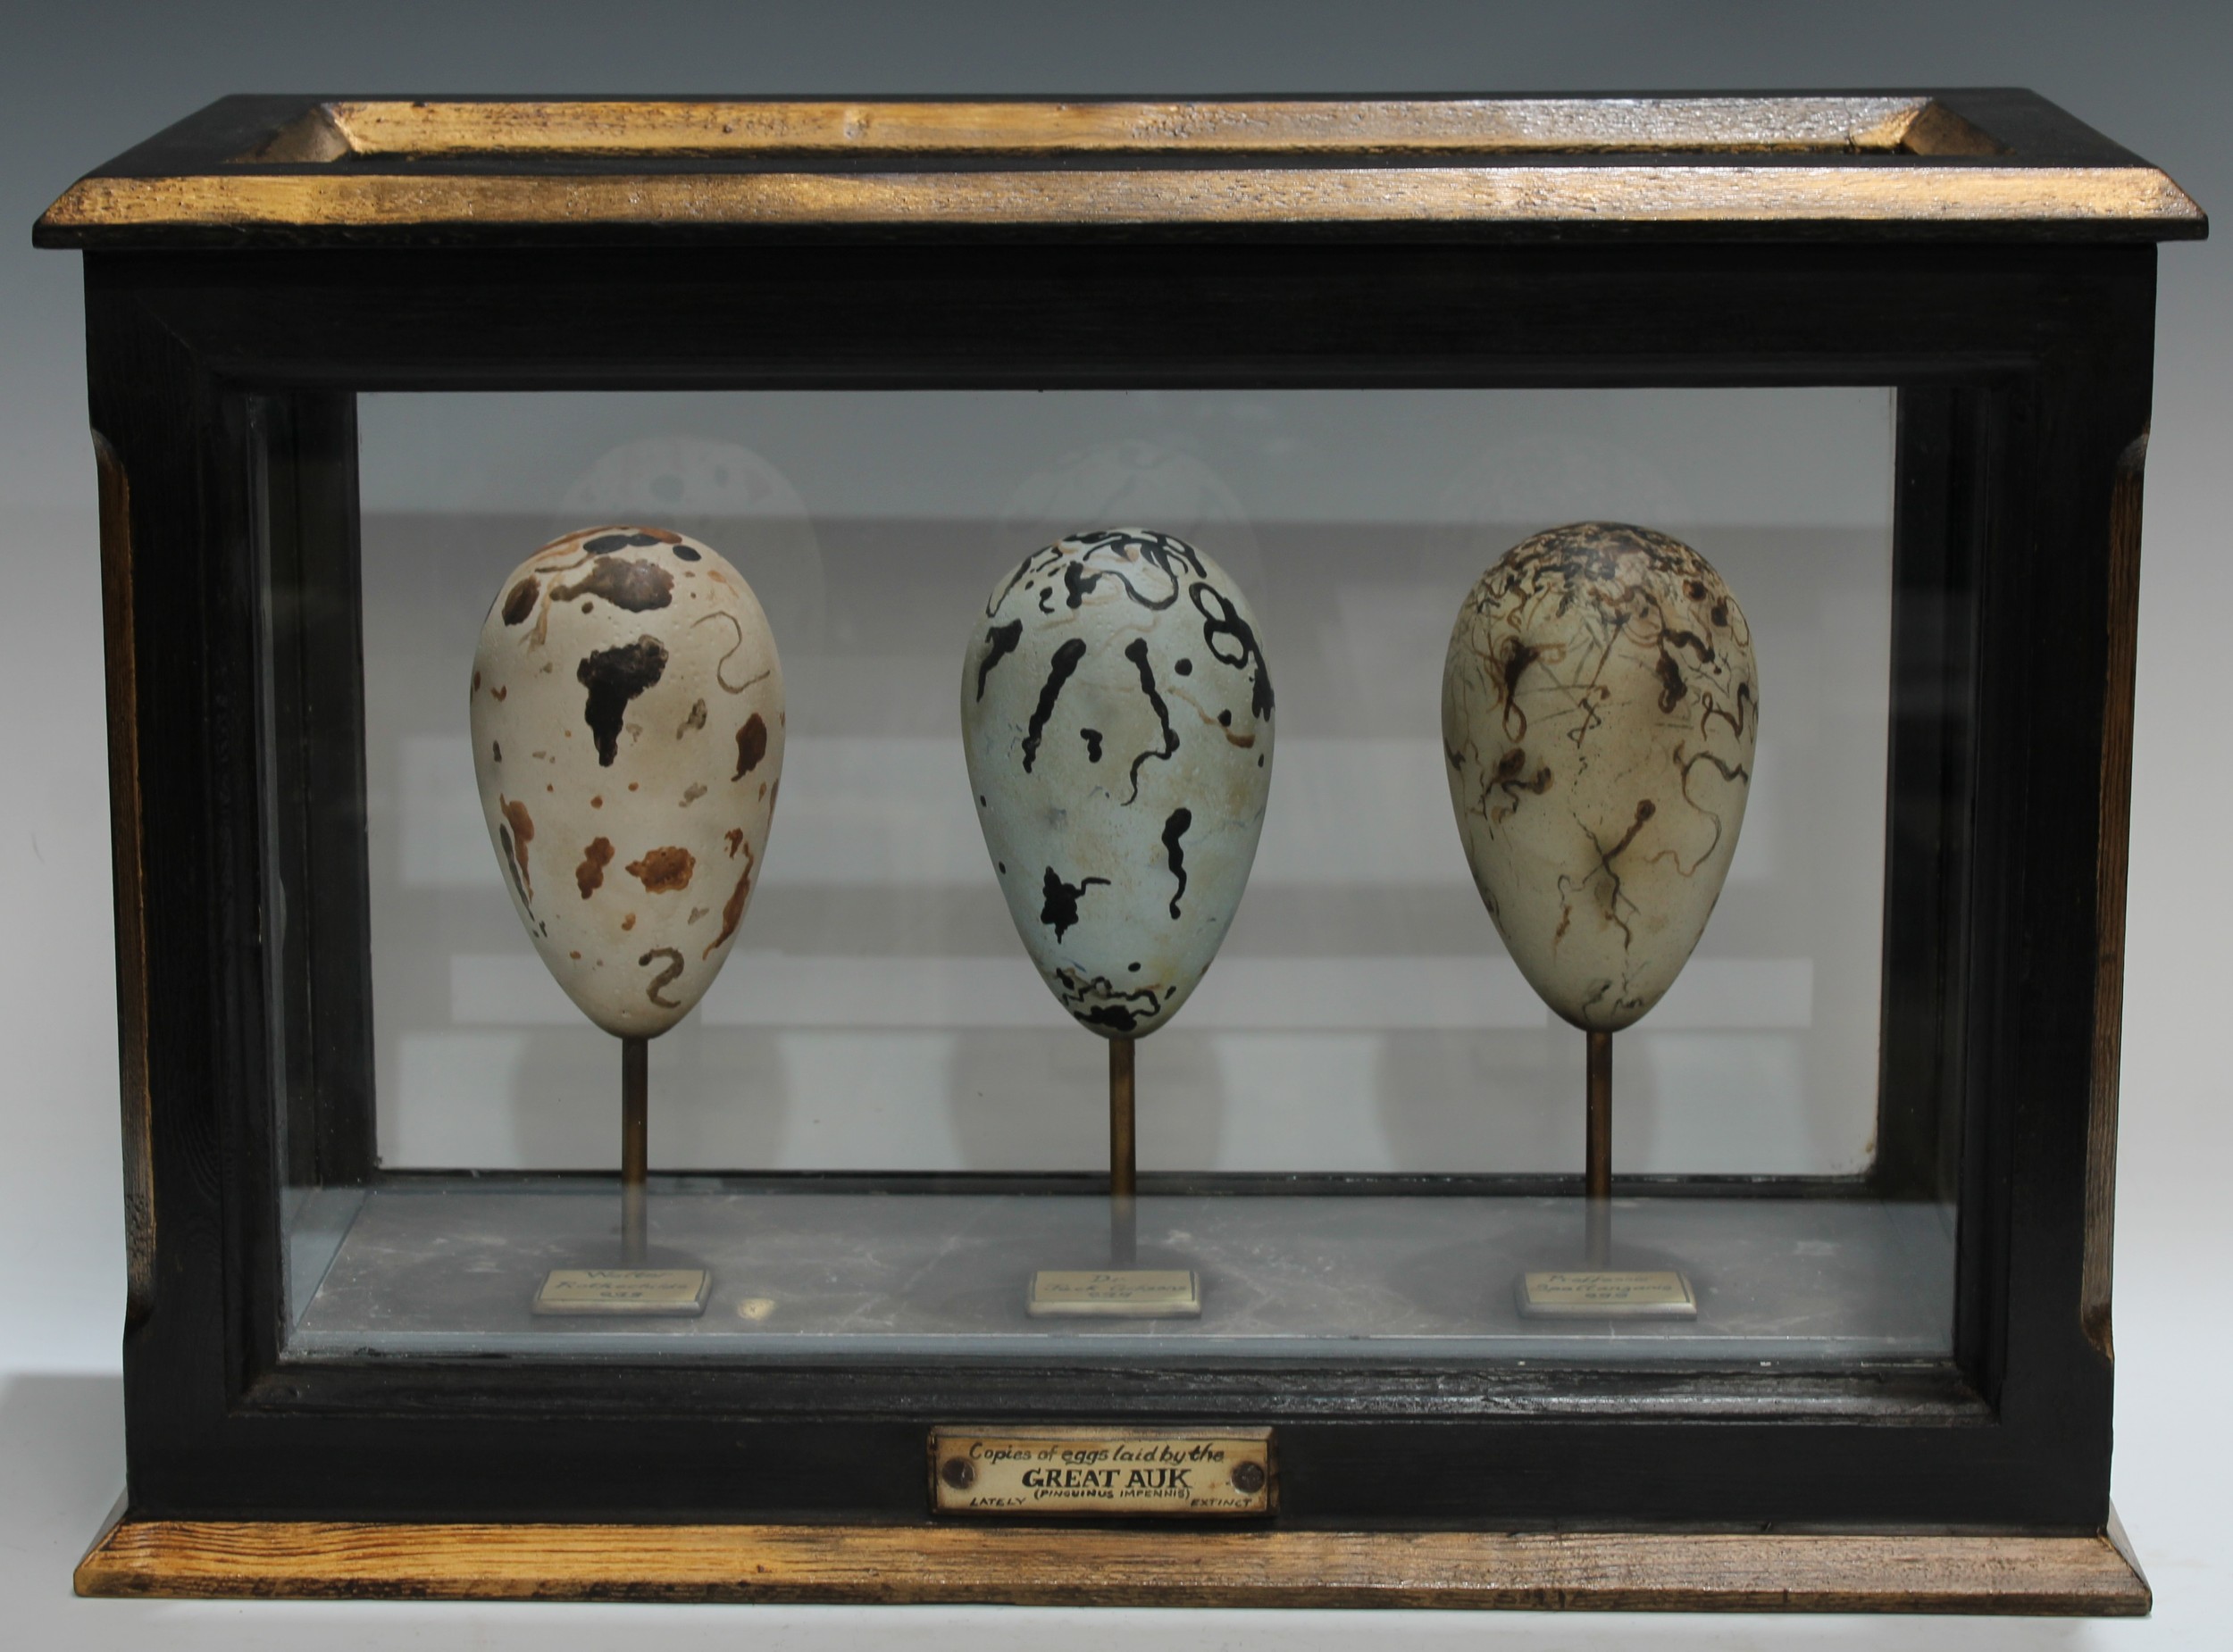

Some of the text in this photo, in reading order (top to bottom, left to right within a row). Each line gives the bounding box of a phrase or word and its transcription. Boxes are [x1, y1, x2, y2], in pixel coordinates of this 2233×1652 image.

[969, 1442, 1225, 1465] Copies of eggs laid by the
[1022, 1467, 1193, 1489] GREAT AUK
[969, 1498, 1252, 1507] LATELY EXTINCT
[1119, 1489, 1191, 1500] IMPENNIS)
